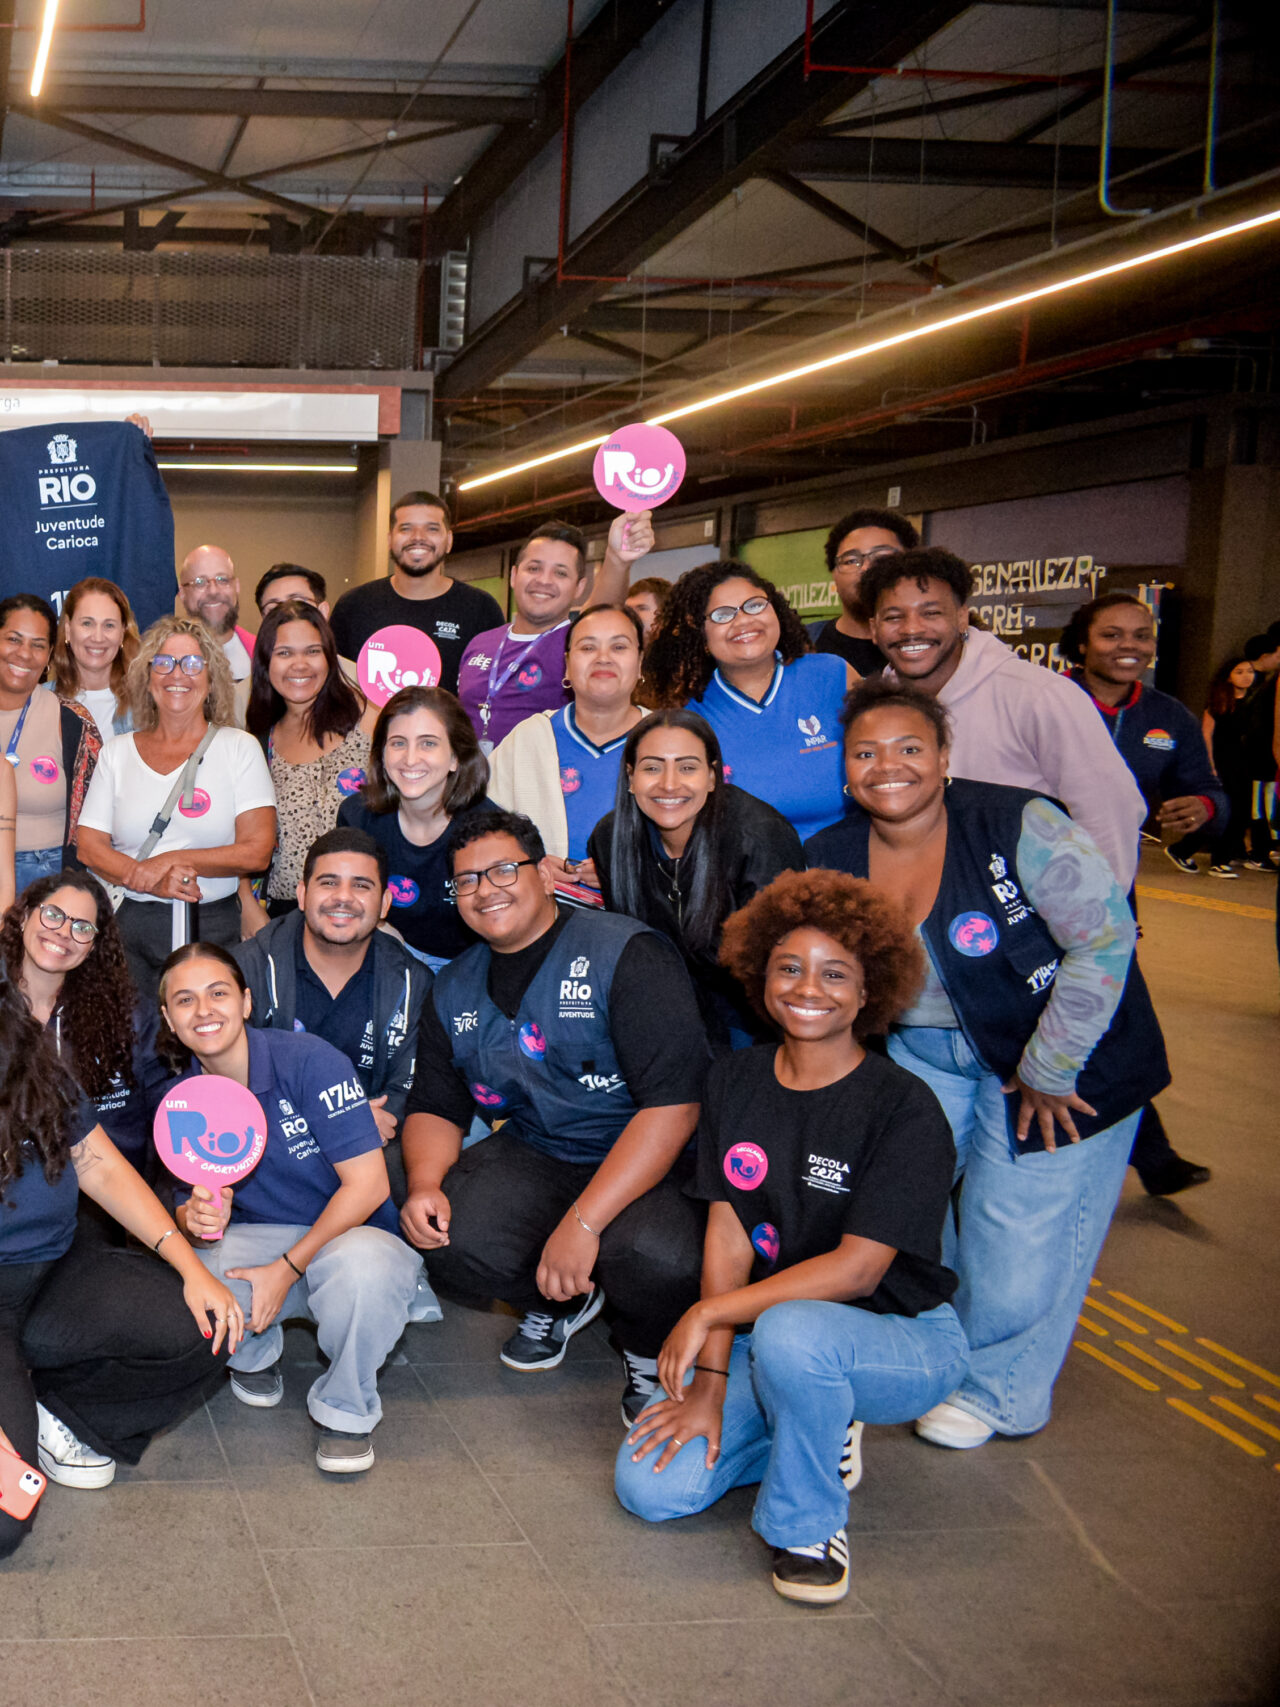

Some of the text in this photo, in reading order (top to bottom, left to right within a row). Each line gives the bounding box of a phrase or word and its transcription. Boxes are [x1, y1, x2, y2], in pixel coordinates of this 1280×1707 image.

[38, 465, 90, 474] PREFEITURA
[38, 473, 96, 505] RIO
[34, 515, 105, 534] Juventude
[46, 536, 99, 550] Carioca
[368, 641, 385, 650] um
[560, 980, 592, 1000] Rio
[558, 1011, 596, 1019] JUVENTUDE
[319, 1077, 365, 1112] 1746
[165, 1100, 188, 1109] um
[184, 1133, 264, 1175] DE OPORTUNIDADES
[808, 1153, 850, 1174] DECOLA
